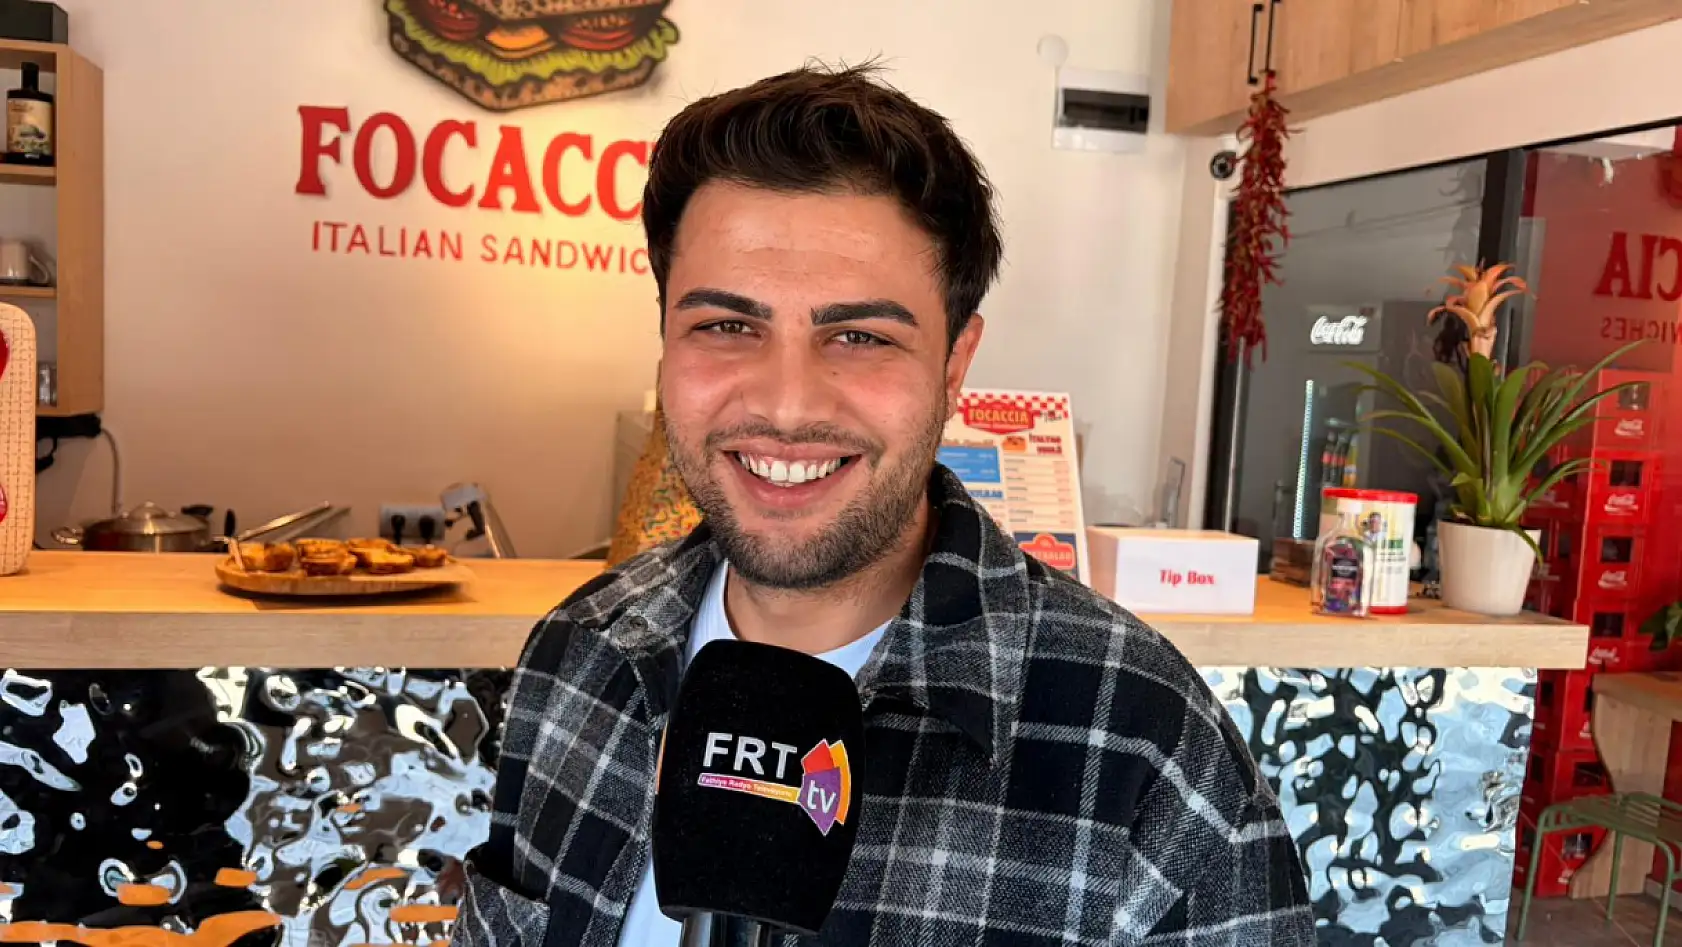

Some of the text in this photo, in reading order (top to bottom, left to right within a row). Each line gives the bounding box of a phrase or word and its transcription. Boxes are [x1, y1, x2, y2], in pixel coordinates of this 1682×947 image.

[295, 105, 657, 221] FOCACC
[312, 220, 463, 261] ITALIAN
[968, 408, 1029, 424] FOCACCIA
[1160, 569, 1214, 588] Tip Box
[702, 732, 797, 779] FRT
[807, 779, 836, 813] tv
